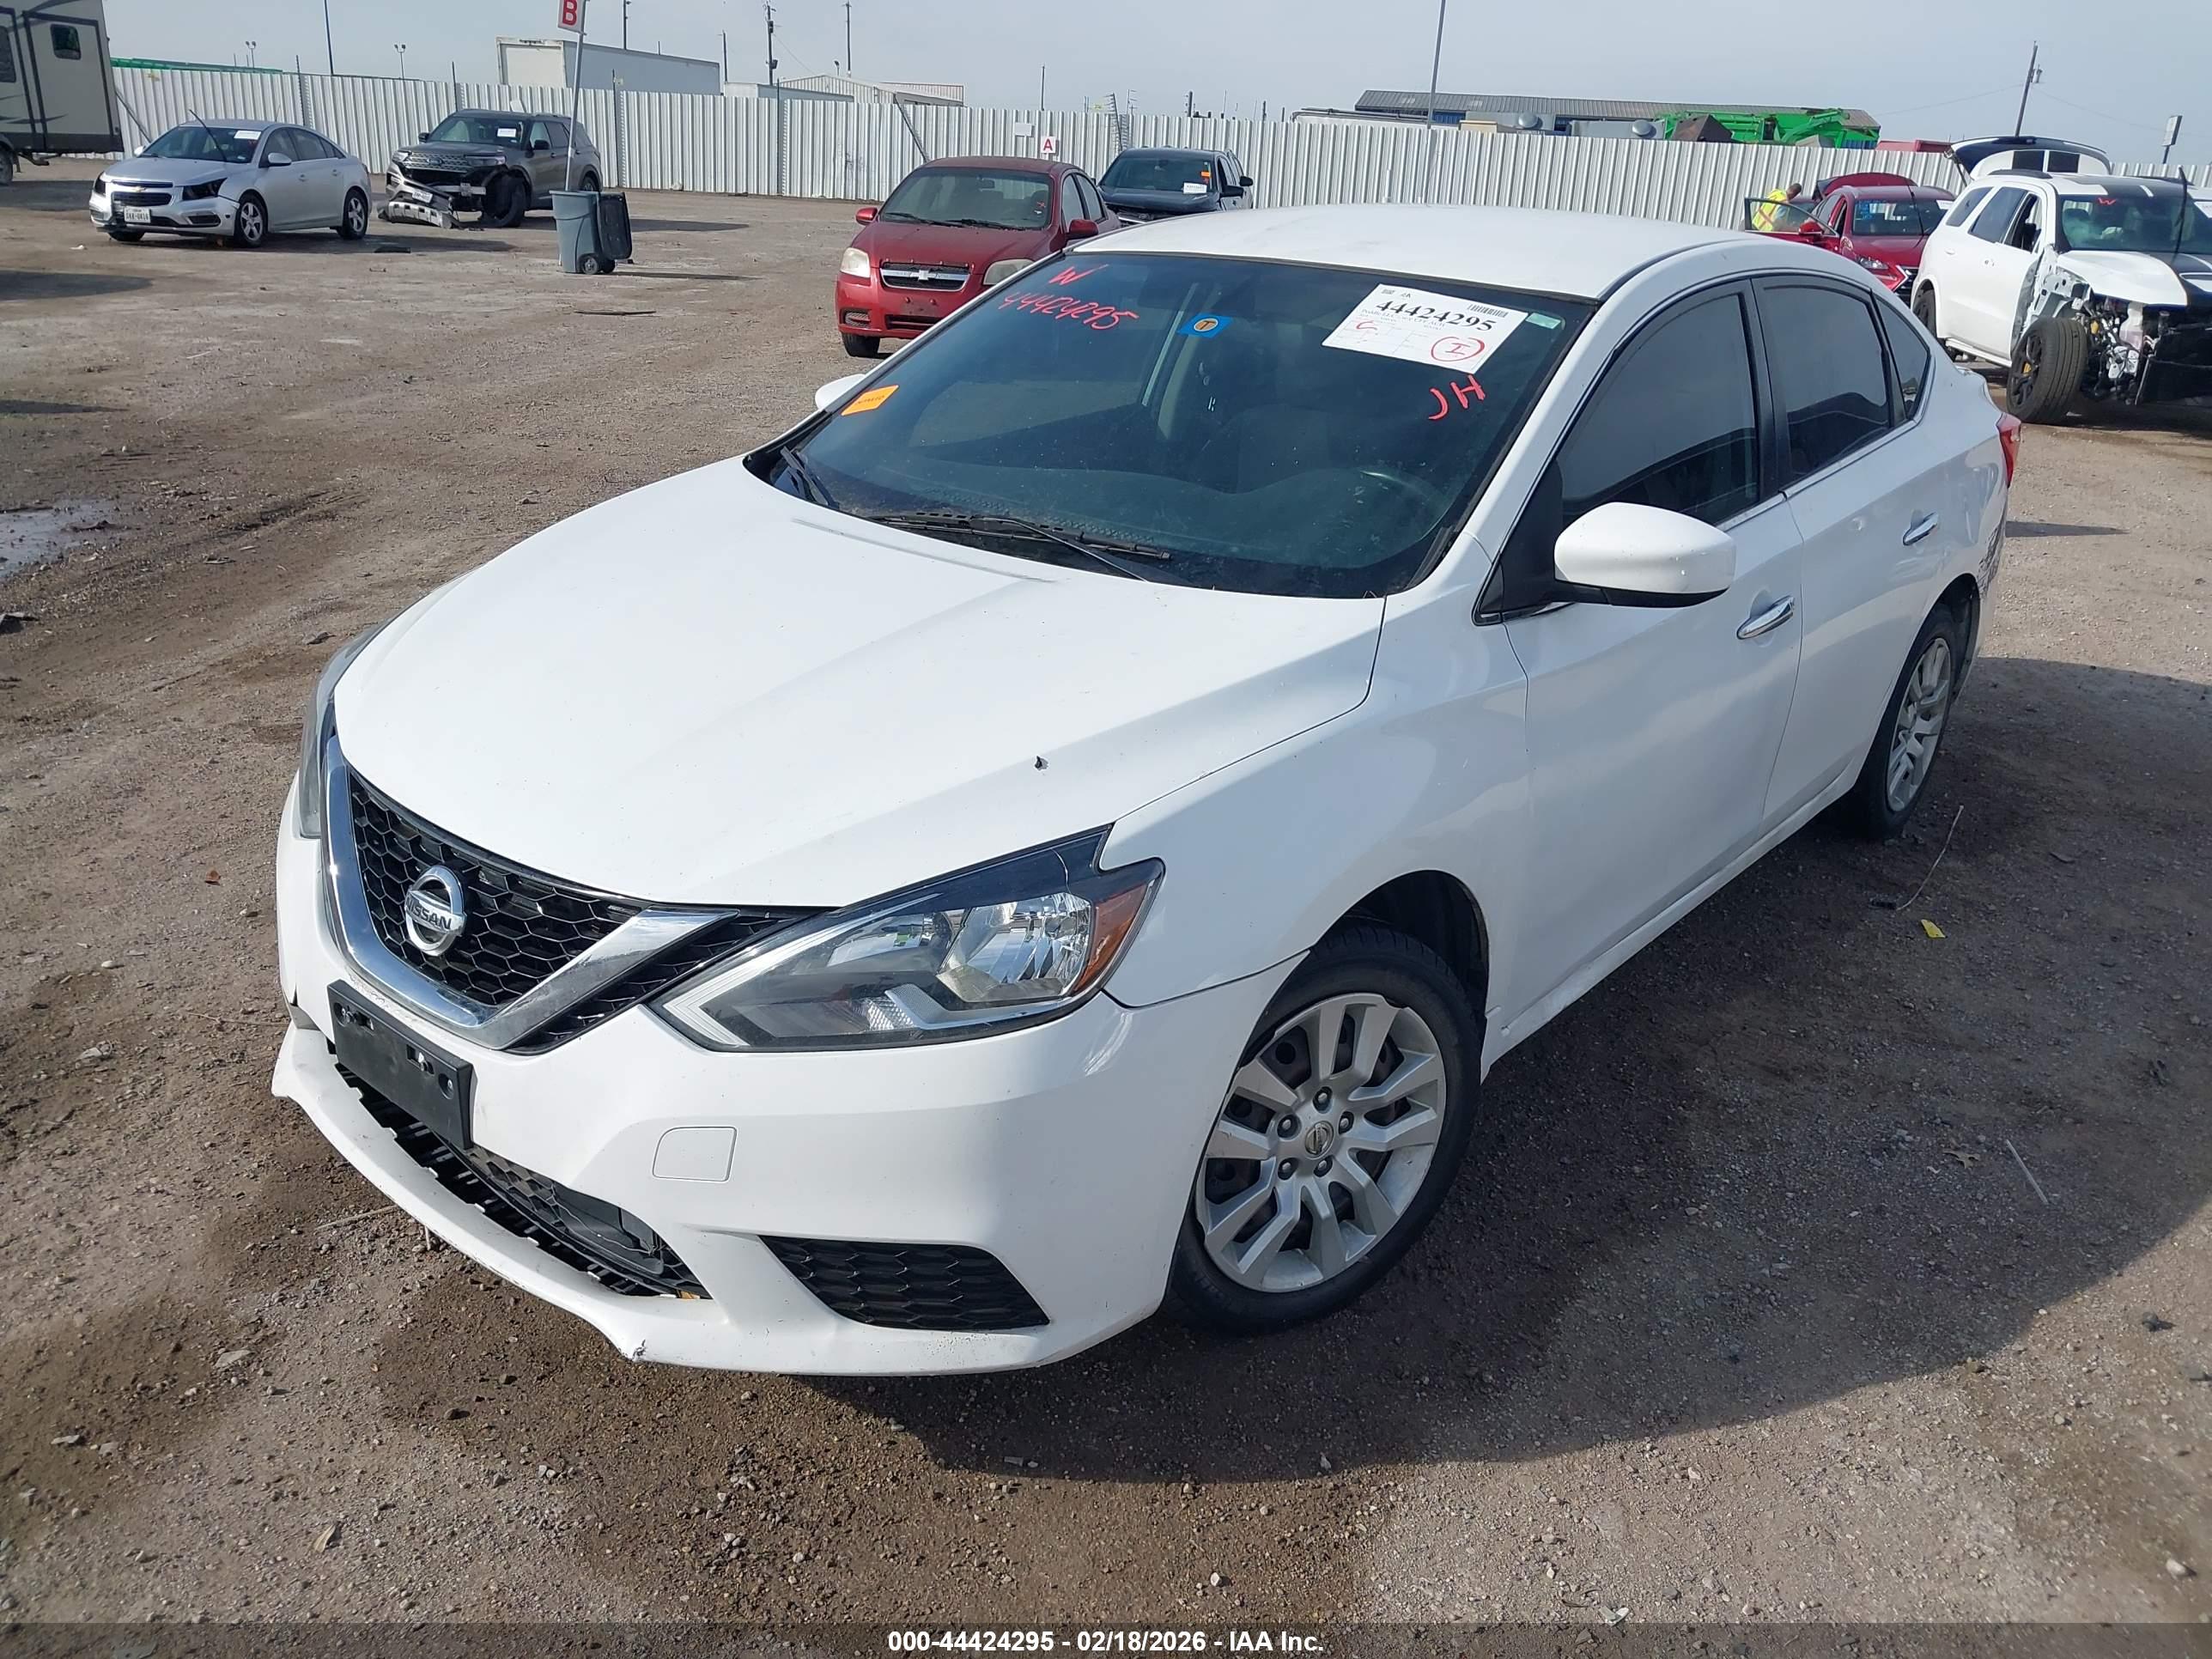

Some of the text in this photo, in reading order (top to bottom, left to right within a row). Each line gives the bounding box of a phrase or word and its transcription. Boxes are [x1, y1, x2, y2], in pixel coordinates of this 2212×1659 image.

[562, 0, 578, 26] B
[1042, 137, 1054, 151] A
[1048, 263, 1109, 286] W
[998, 291, 1140, 331] 44424295
[1376, 301, 1497, 332] 44424295
[405, 895, 453, 931] NISSAN
